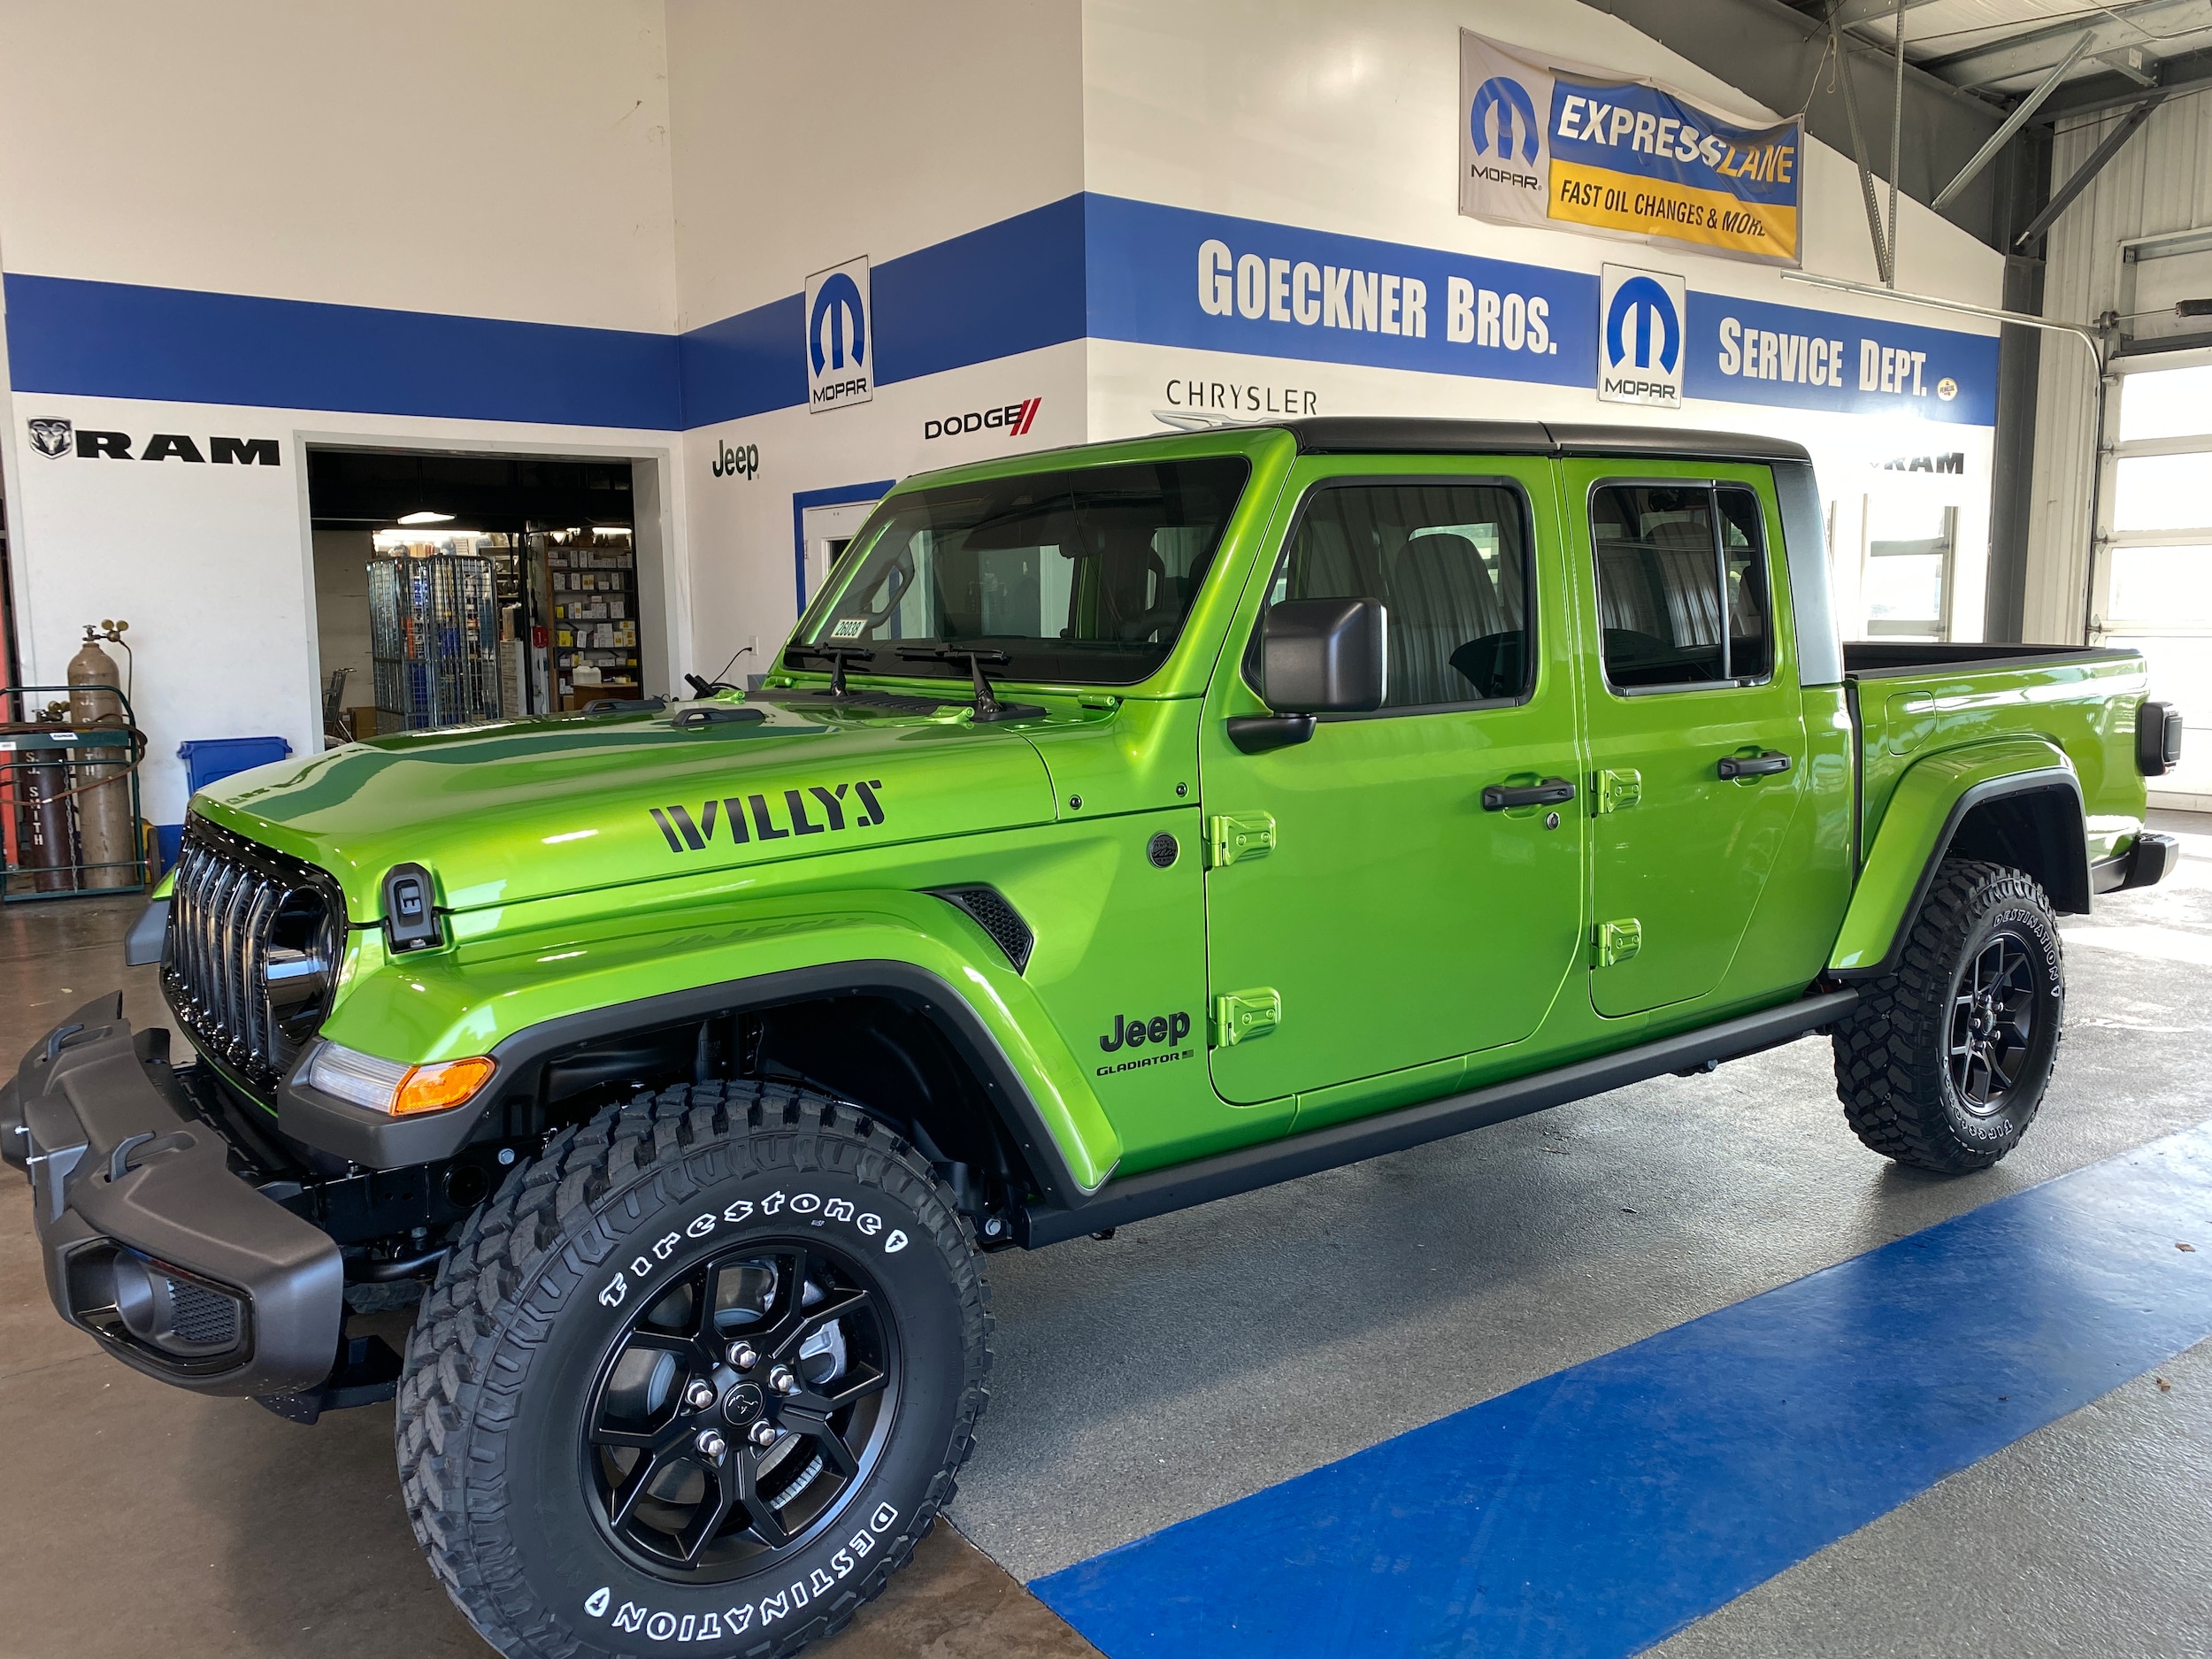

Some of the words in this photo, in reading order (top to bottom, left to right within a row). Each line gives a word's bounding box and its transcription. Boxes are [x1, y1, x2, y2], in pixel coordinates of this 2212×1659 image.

[1559, 179, 1604, 209] FAST
[1604, 188, 1630, 215] OIL
[1633, 195, 1704, 229] CHANGES
[1707, 208, 1717, 229] &
[1197, 238, 1427, 339] GOECKNER
[1447, 276, 1557, 355] BROS.
[1718, 317, 1844, 388] SERVICE
[1859, 338, 1927, 396] DEPT.
[813, 377, 868, 403] MOPAR
[1166, 379, 1317, 416] CHRYSLER
[1604, 377, 1676, 399] MOPAR
[925, 404, 1025, 440] DODGE
[76, 429, 280, 467] RAM
[712, 439, 758, 480] Jeep
[834, 621, 861, 636] 26038
[29, 787, 43, 846] SMITH
[649, 780, 885, 853] WILLYS
[1993, 909, 2059, 981] DESTINATION
[1099, 1011, 1191, 1053] Jeep
[1096, 1052, 1180, 1077] GLADIATOR
[598, 1190, 883, 1308] Firestone
[612, 1502, 899, 1642] DESTINATION
